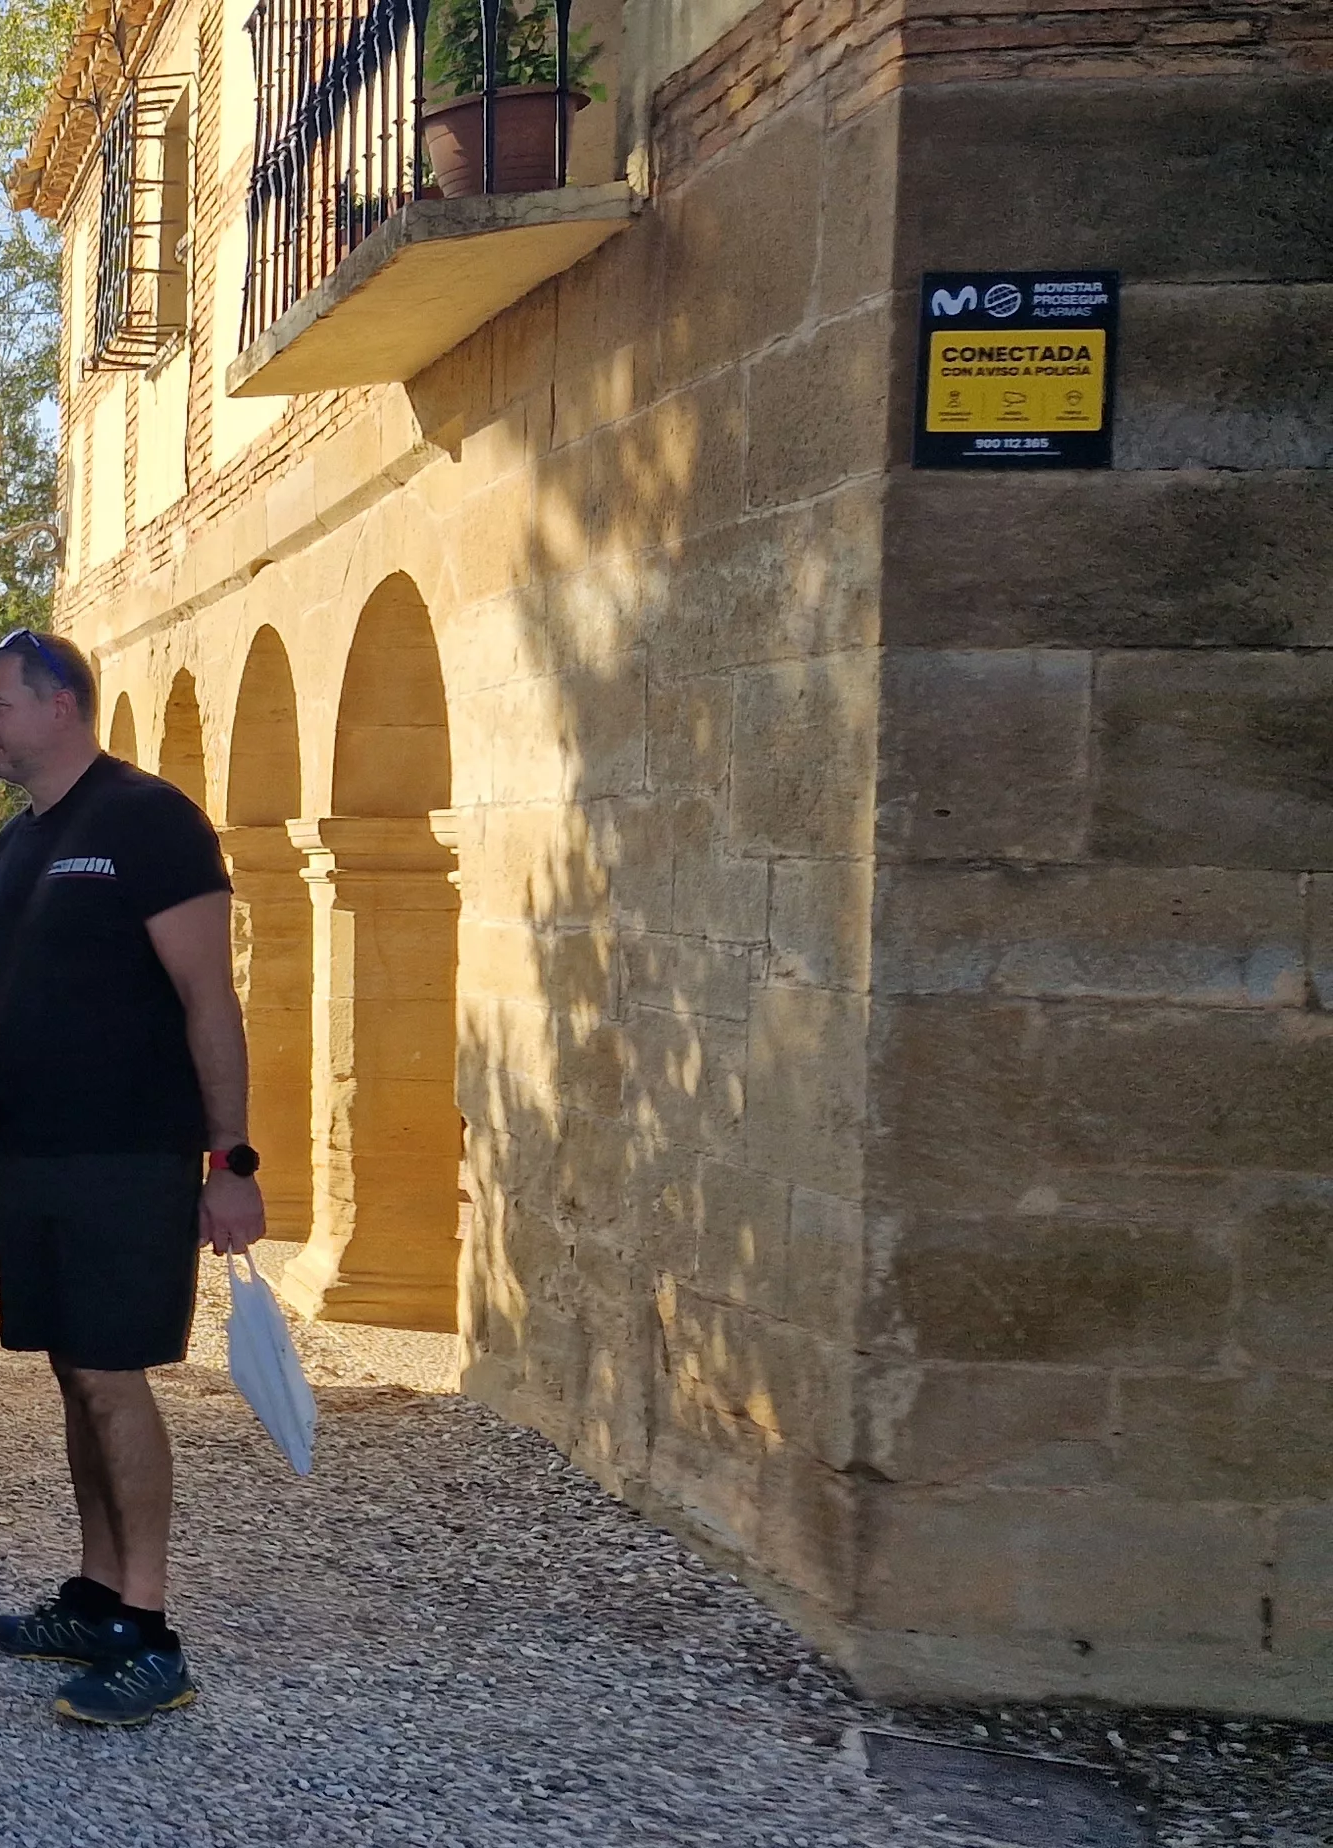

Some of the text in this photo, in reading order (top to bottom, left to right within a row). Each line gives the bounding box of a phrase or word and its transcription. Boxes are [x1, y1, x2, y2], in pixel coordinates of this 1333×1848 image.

[1034, 282, 1103, 293] MOVISTAR
[1033, 294, 1108, 305] PROSEGUR
[1032, 306, 1093, 317] ALARMAS
[942, 345, 1092, 362] CONECTADA
[941, 367, 972, 377] CON
[975, 366, 1019, 377] AVISO
[1022, 366, 1031, 376] A
[975, 438, 1001, 449] 900
